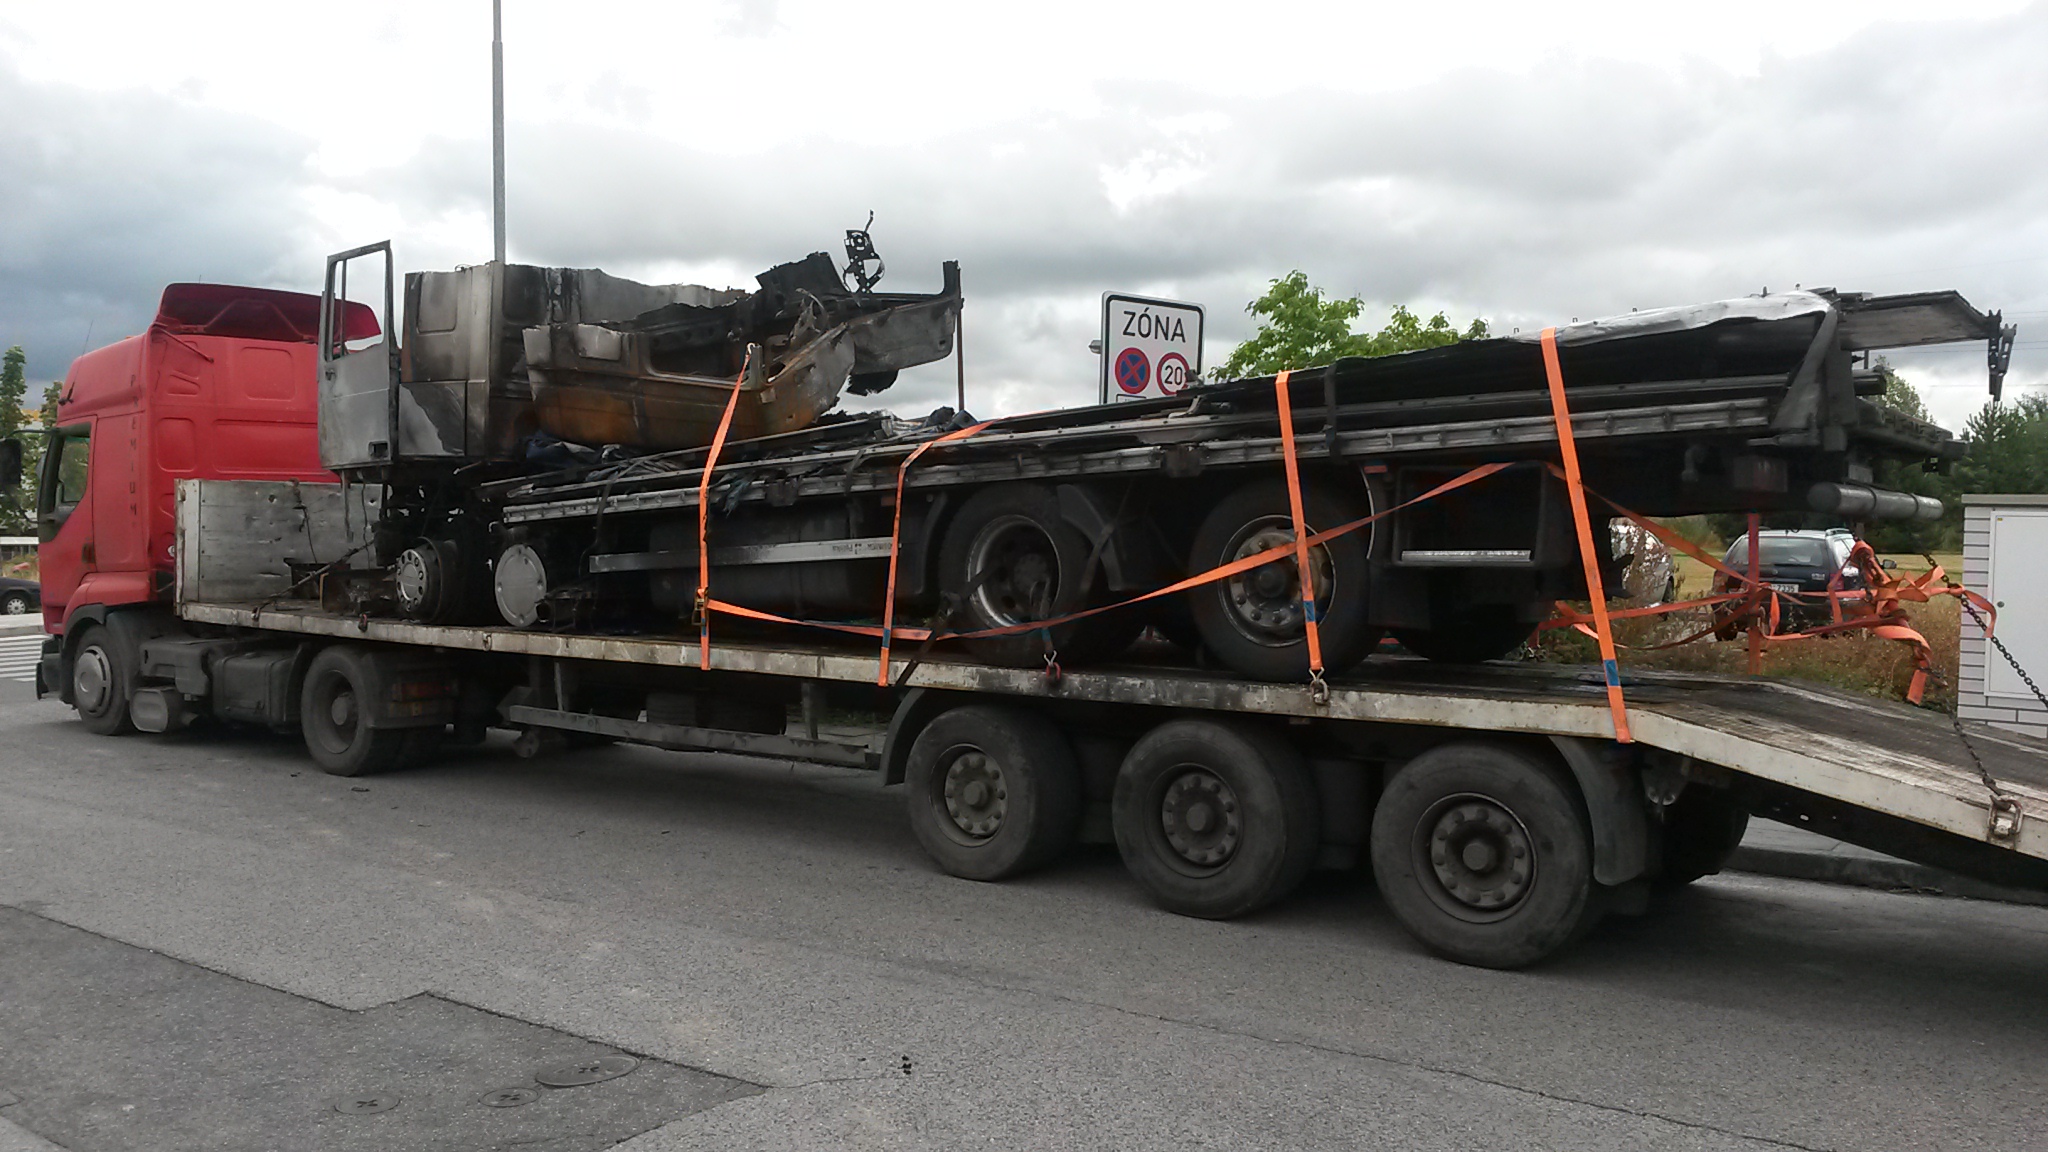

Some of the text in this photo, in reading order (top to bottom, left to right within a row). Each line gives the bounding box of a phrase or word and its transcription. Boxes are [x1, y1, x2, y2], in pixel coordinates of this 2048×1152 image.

[1122, 307, 1186, 343] ZÓNA
[1164, 365, 1183, 386] 20
[129, 374, 139, 516] PREMIUM
